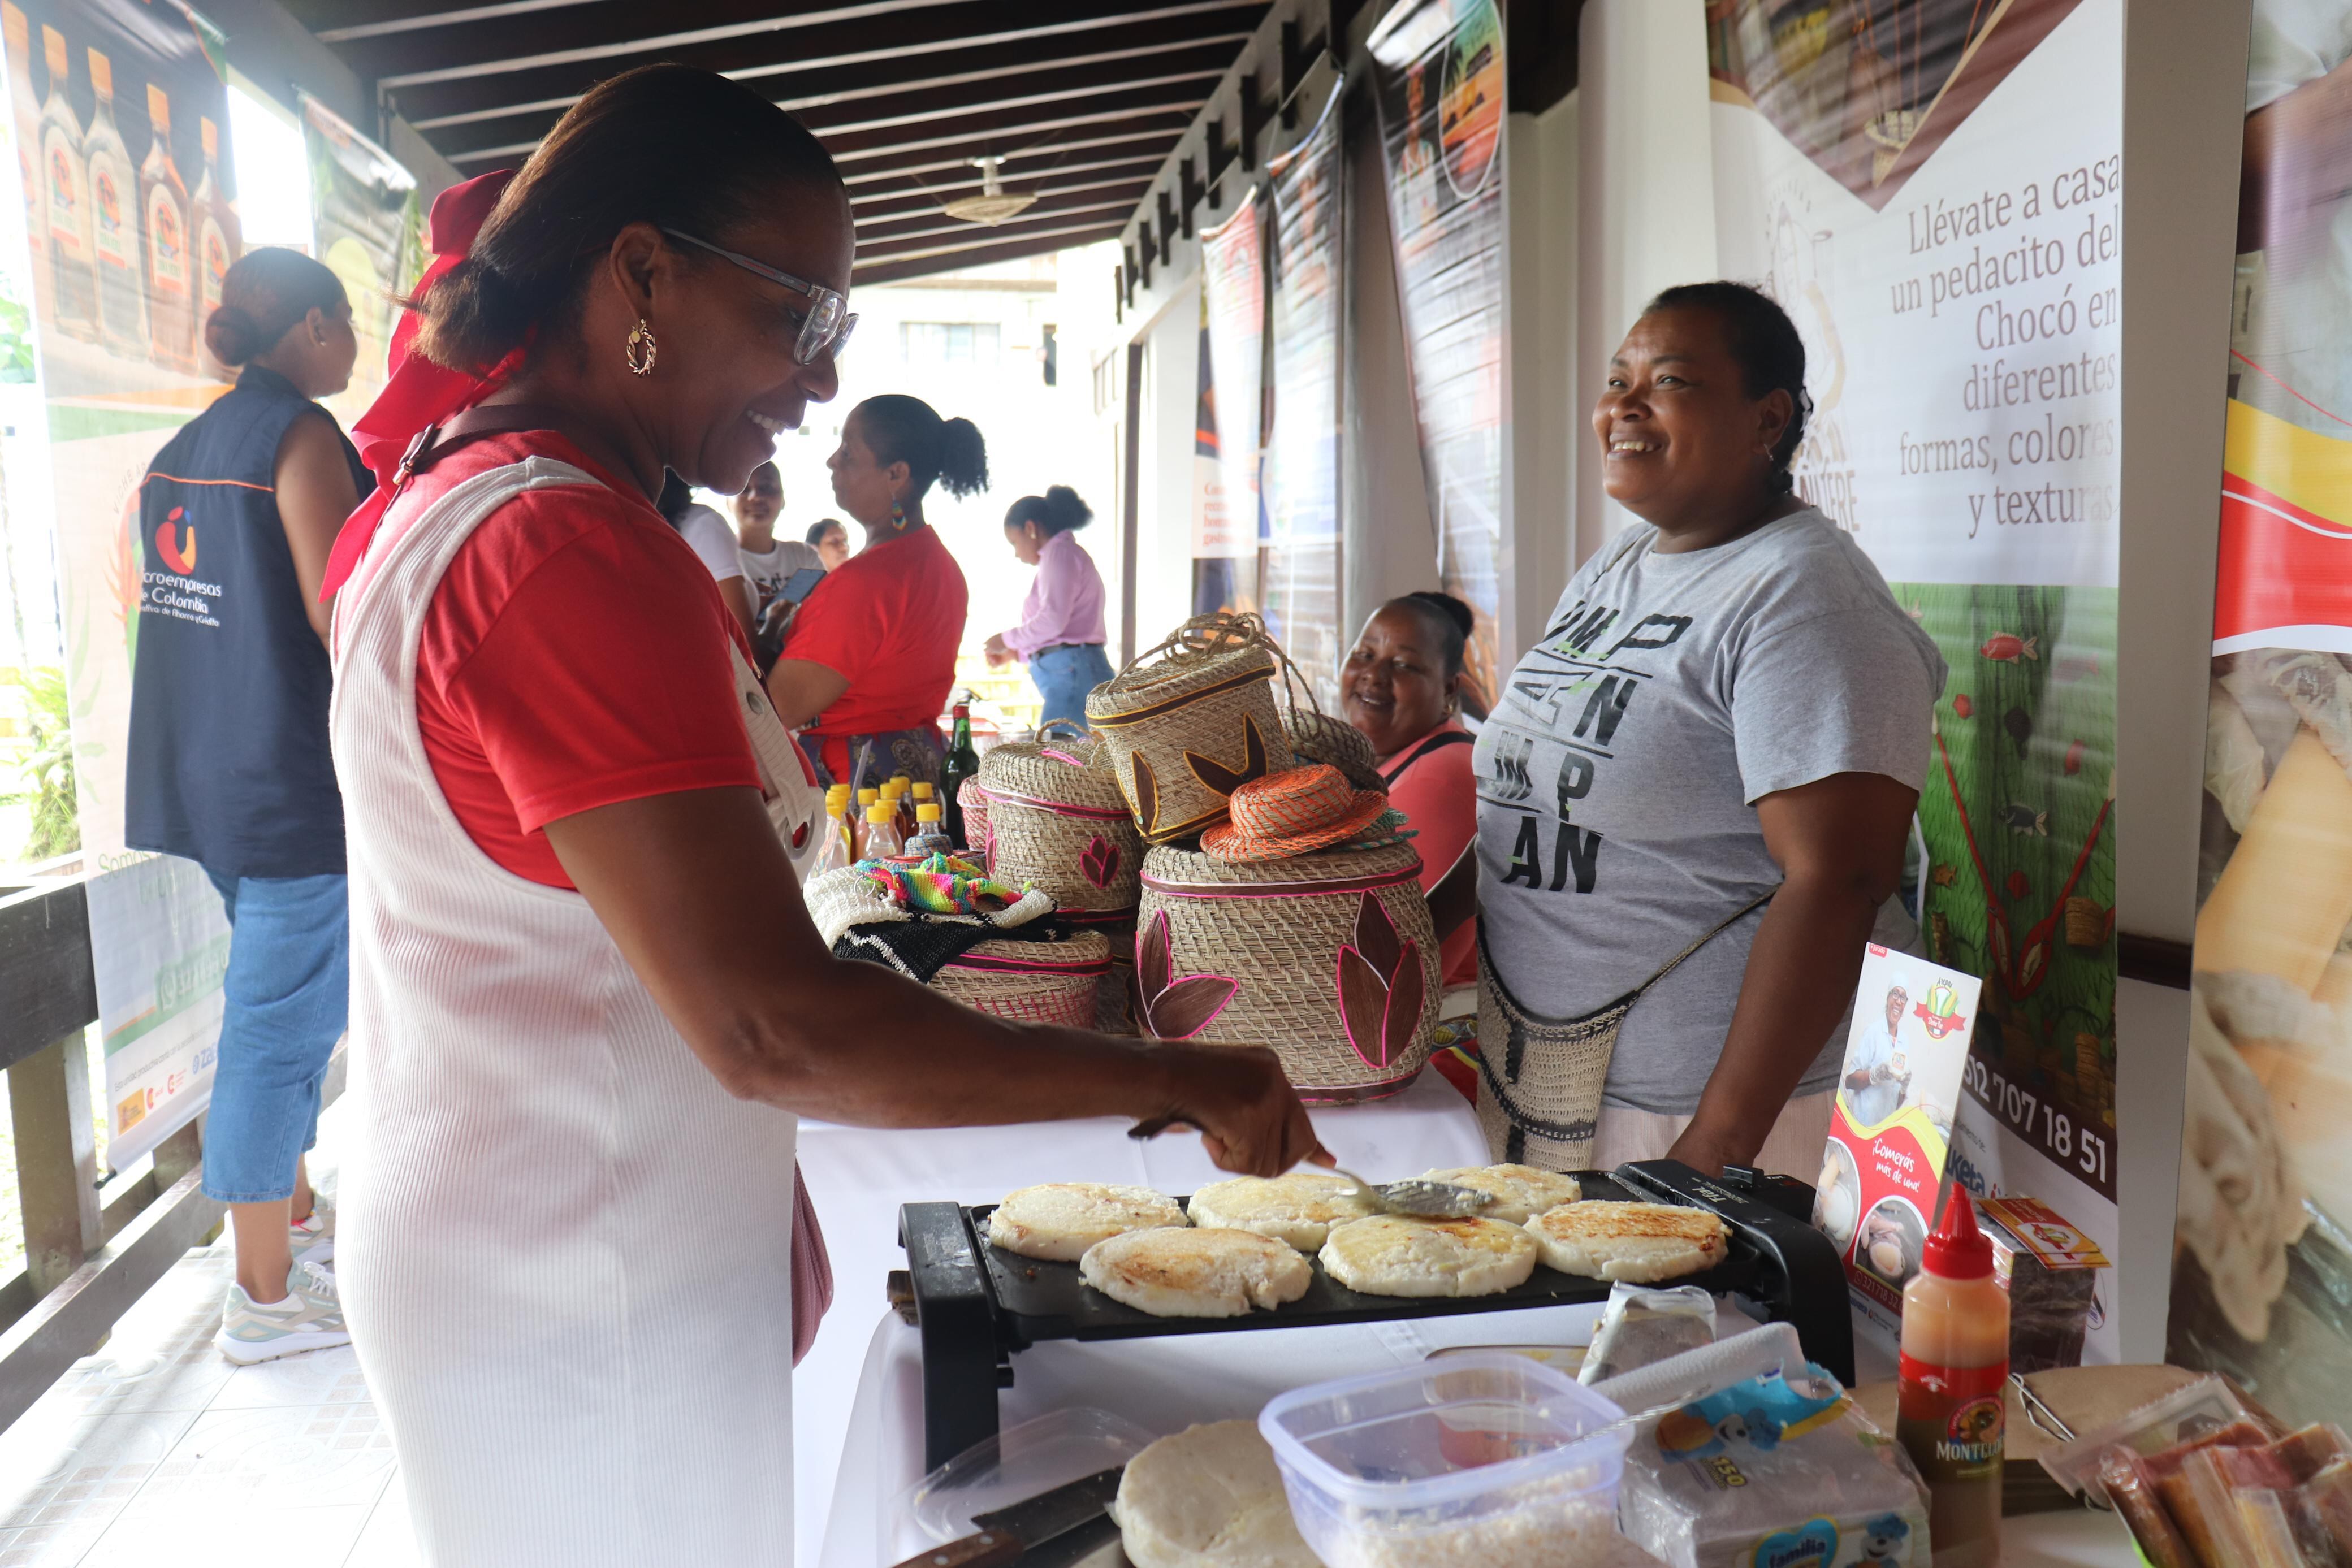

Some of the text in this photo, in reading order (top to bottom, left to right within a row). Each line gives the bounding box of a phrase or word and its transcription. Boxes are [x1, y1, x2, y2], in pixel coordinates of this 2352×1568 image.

[1909, 154, 2119, 254] Llévate a casa
[1891, 203, 2118, 318] un pedacito del
[1976, 283, 2116, 351] Chocó en
[1964, 352, 2115, 412] diferentes
[1900, 413, 2114, 475] formas, colores
[1968, 482, 2113, 539] y texturas
[142, 572, 222, 597] croempresas
[151, 587, 209, 614] Colombia
[98, 850, 150, 883] Somos
[1873, 1138, 1914, 1172] ¡Comerás
[1992, 1072, 2037, 1133] 707
[2043, 1104, 2072, 1157] 18
[2079, 1128, 2105, 1183] 51
[1876, 1162, 1921, 1193] más de una!
